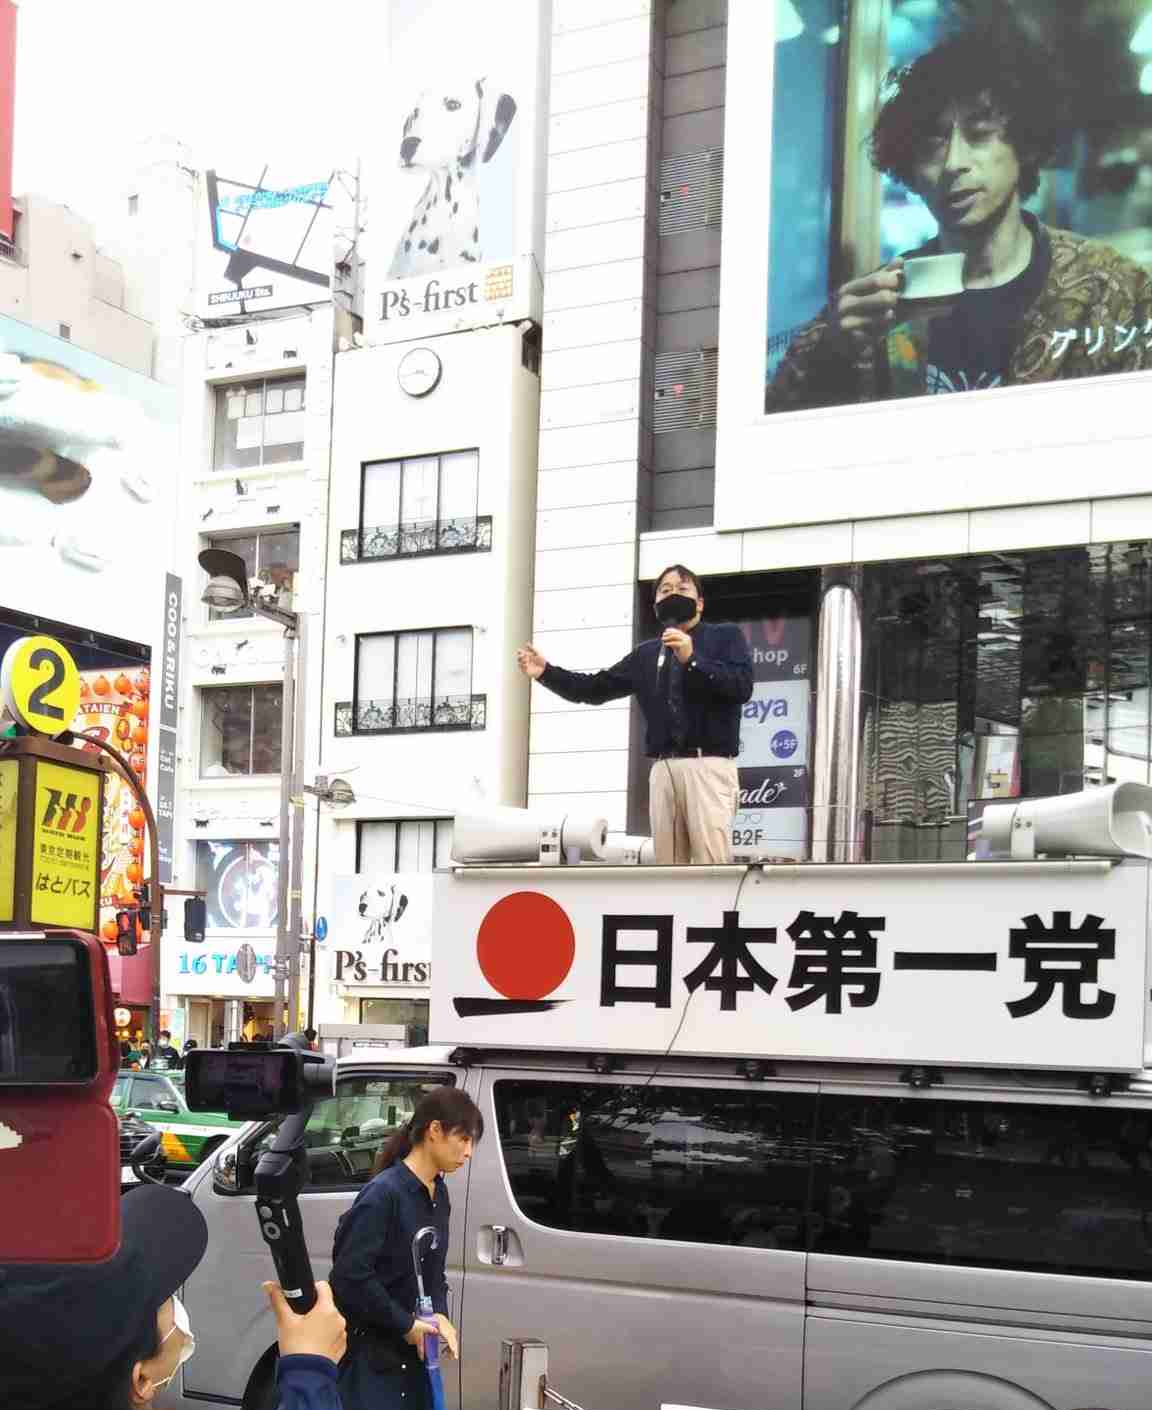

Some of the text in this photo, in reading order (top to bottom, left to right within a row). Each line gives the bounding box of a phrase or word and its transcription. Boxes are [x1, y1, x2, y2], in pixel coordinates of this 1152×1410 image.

[380, 280, 478, 320] P's-first
[165, 591, 178, 711] COO&RIKU
[753, 647, 789, 666] hop
[28, 647, 66, 721] 2
[743, 697, 788, 724] aya
[732, 829, 763, 846] B2F
[36, 873, 91, 899] はとバス
[600, 910, 1116, 1019] 日本第一党
